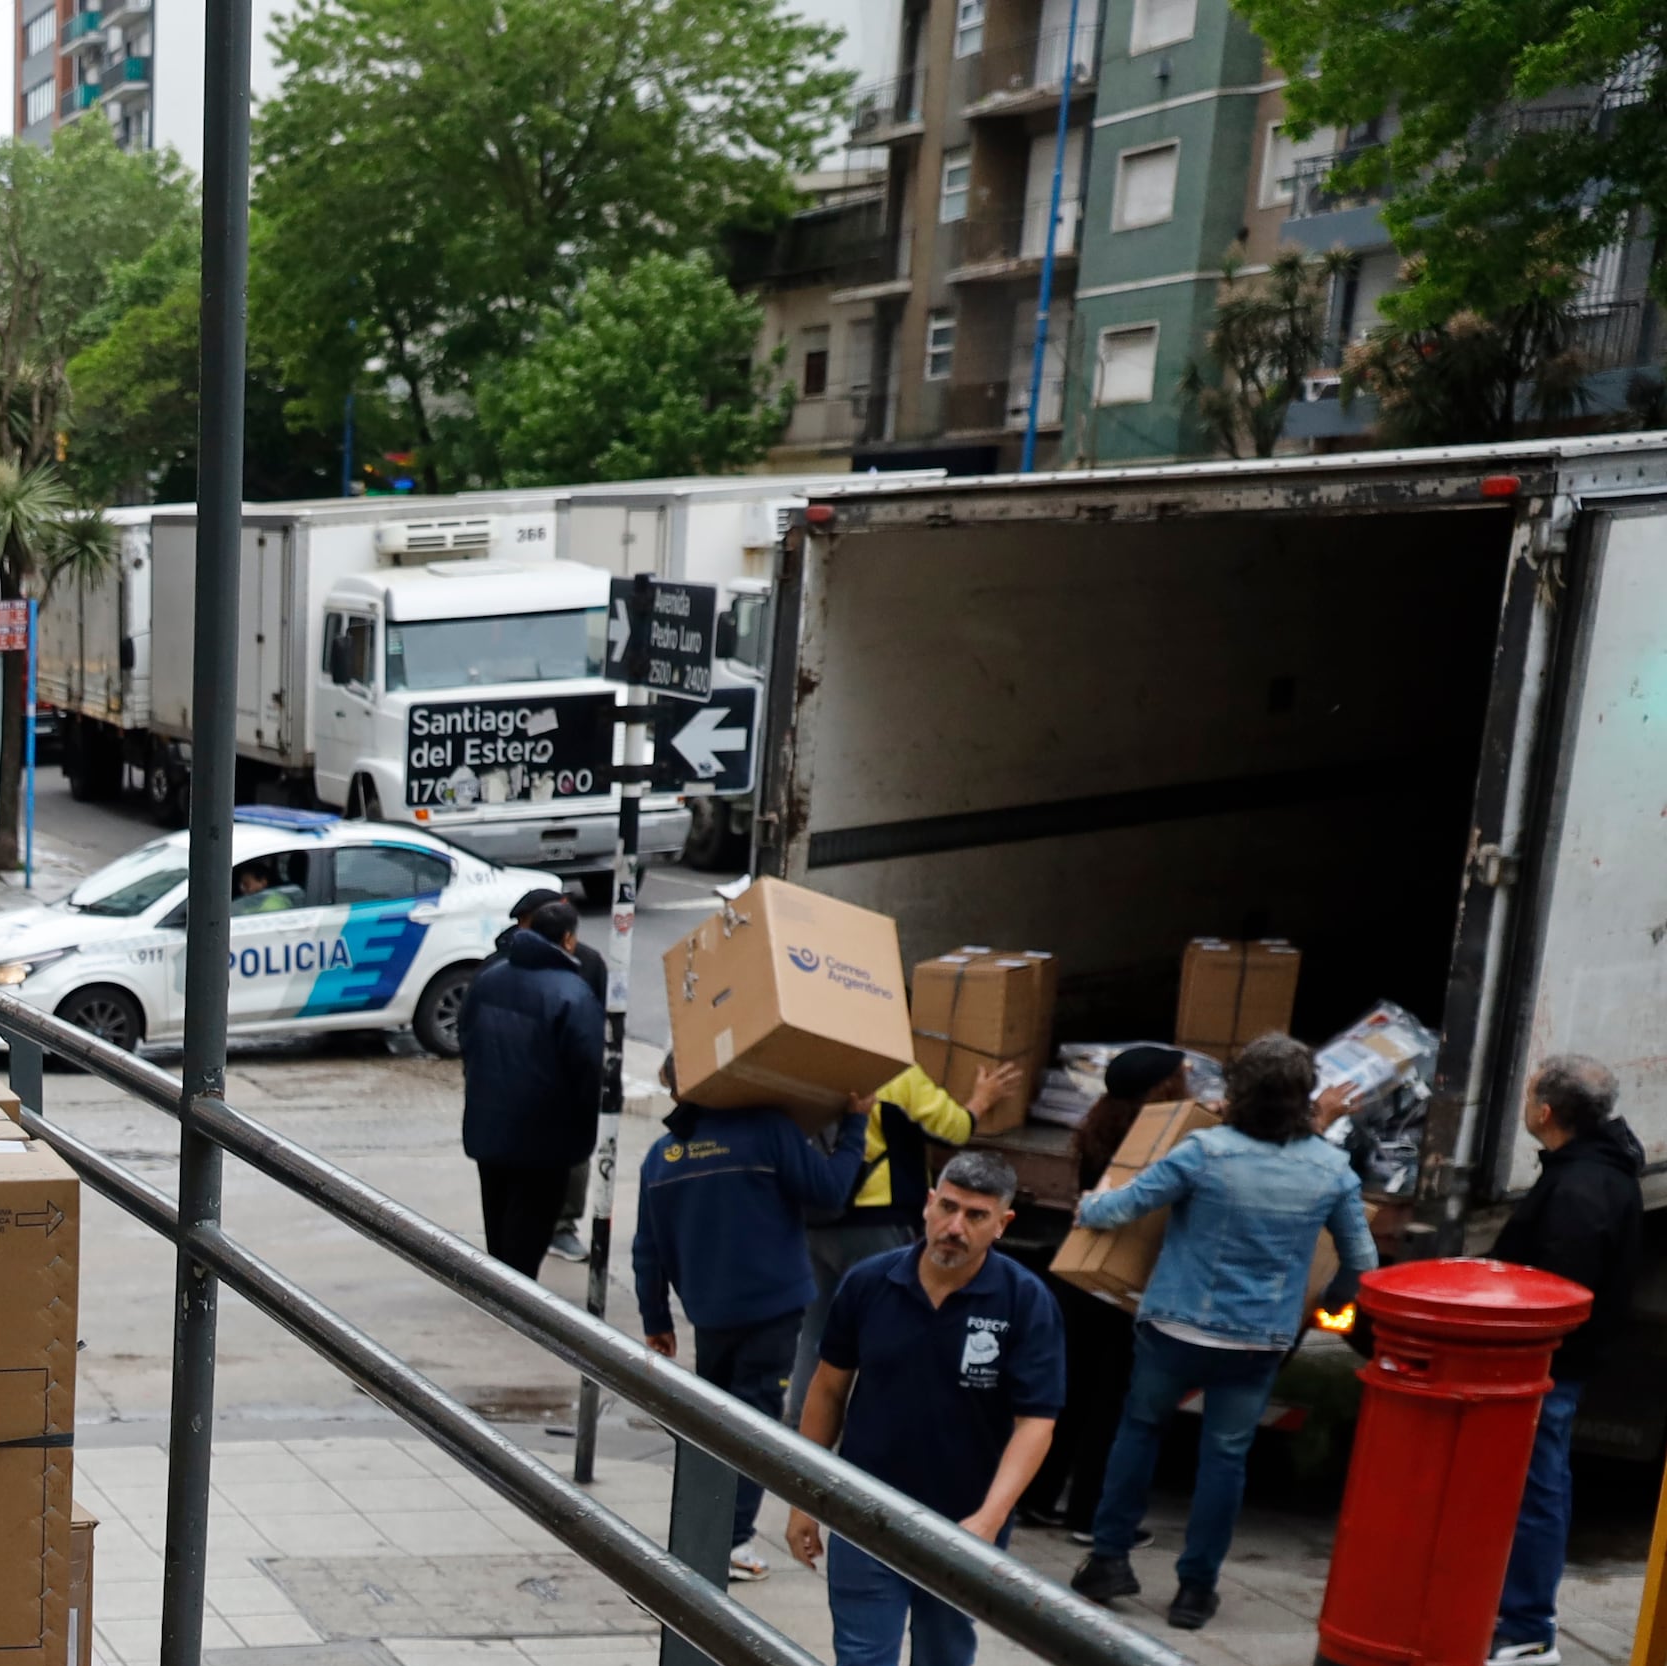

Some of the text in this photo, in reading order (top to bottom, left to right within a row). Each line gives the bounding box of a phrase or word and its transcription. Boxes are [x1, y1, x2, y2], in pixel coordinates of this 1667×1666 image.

[650, 620, 703, 654] Pedro Luro
[412, 706, 533, 737] Santiago
[410, 737, 554, 769] del Estero
[138, 948, 163, 965] 911
